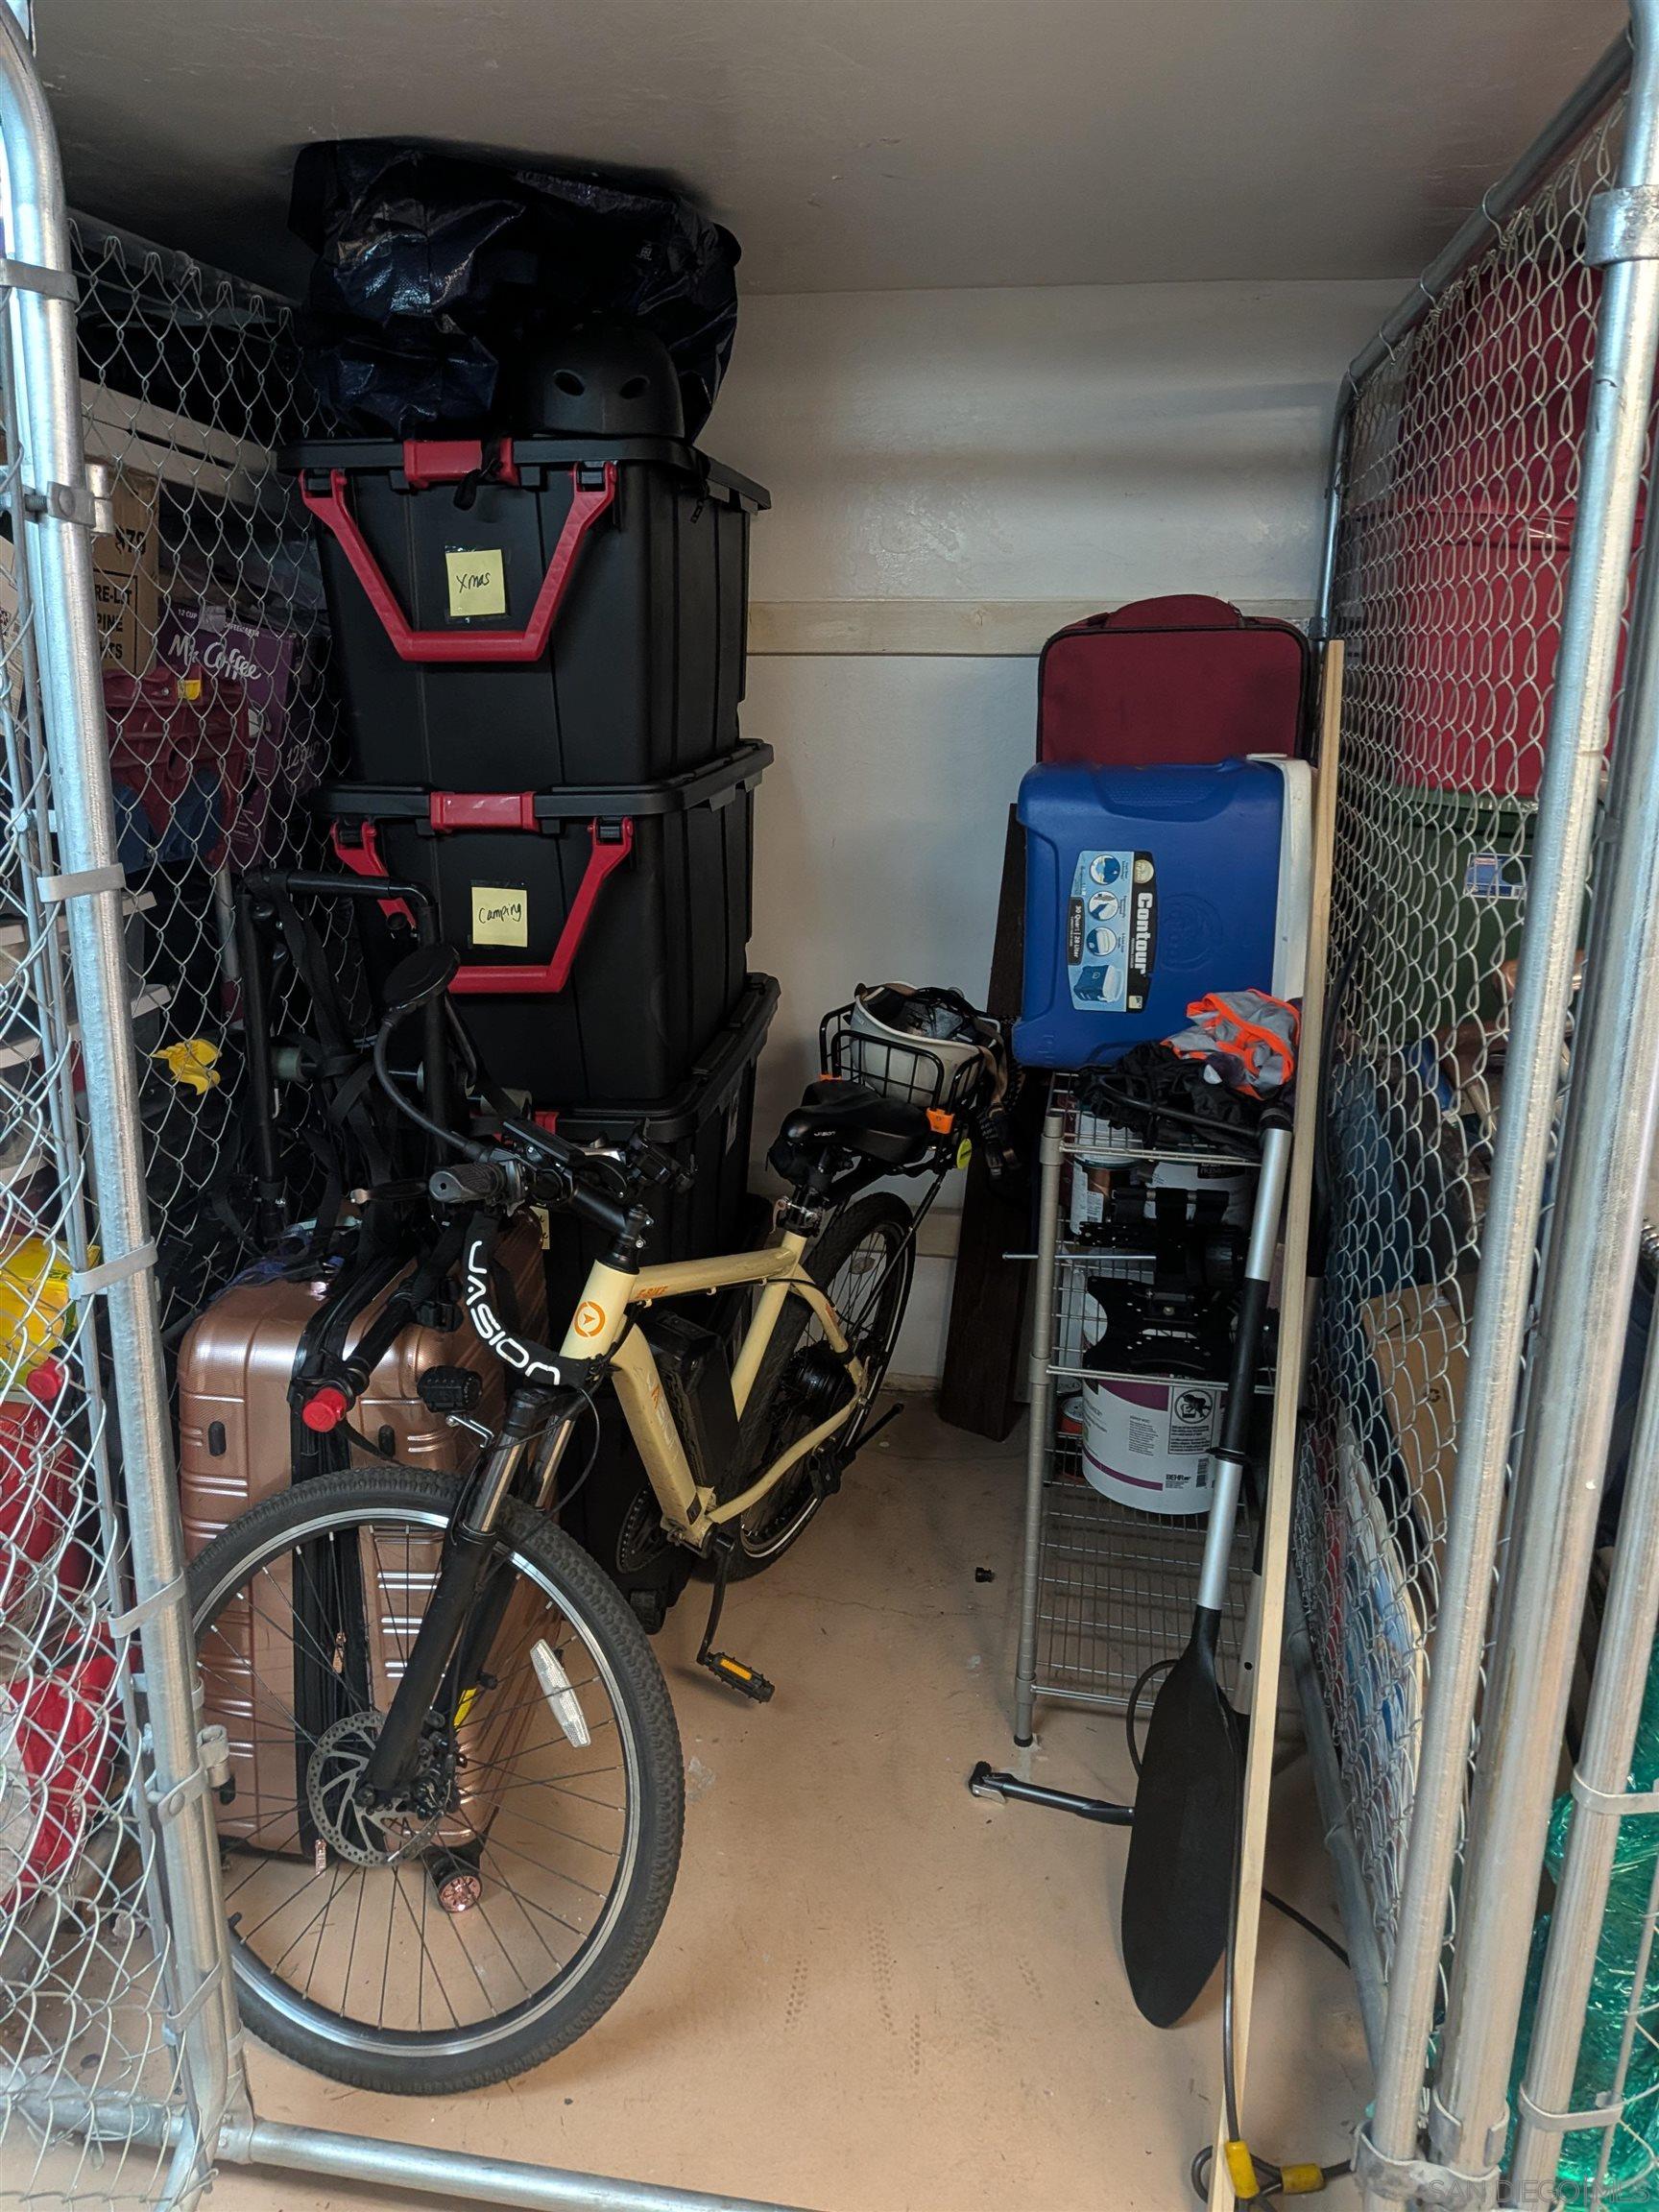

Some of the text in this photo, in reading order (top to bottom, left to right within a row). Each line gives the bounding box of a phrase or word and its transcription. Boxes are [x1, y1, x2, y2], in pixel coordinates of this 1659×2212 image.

[204, 641, 262, 680] Coffee
[478, 902, 522, 925] Camping
[1135, 892, 1153, 975] Contour
